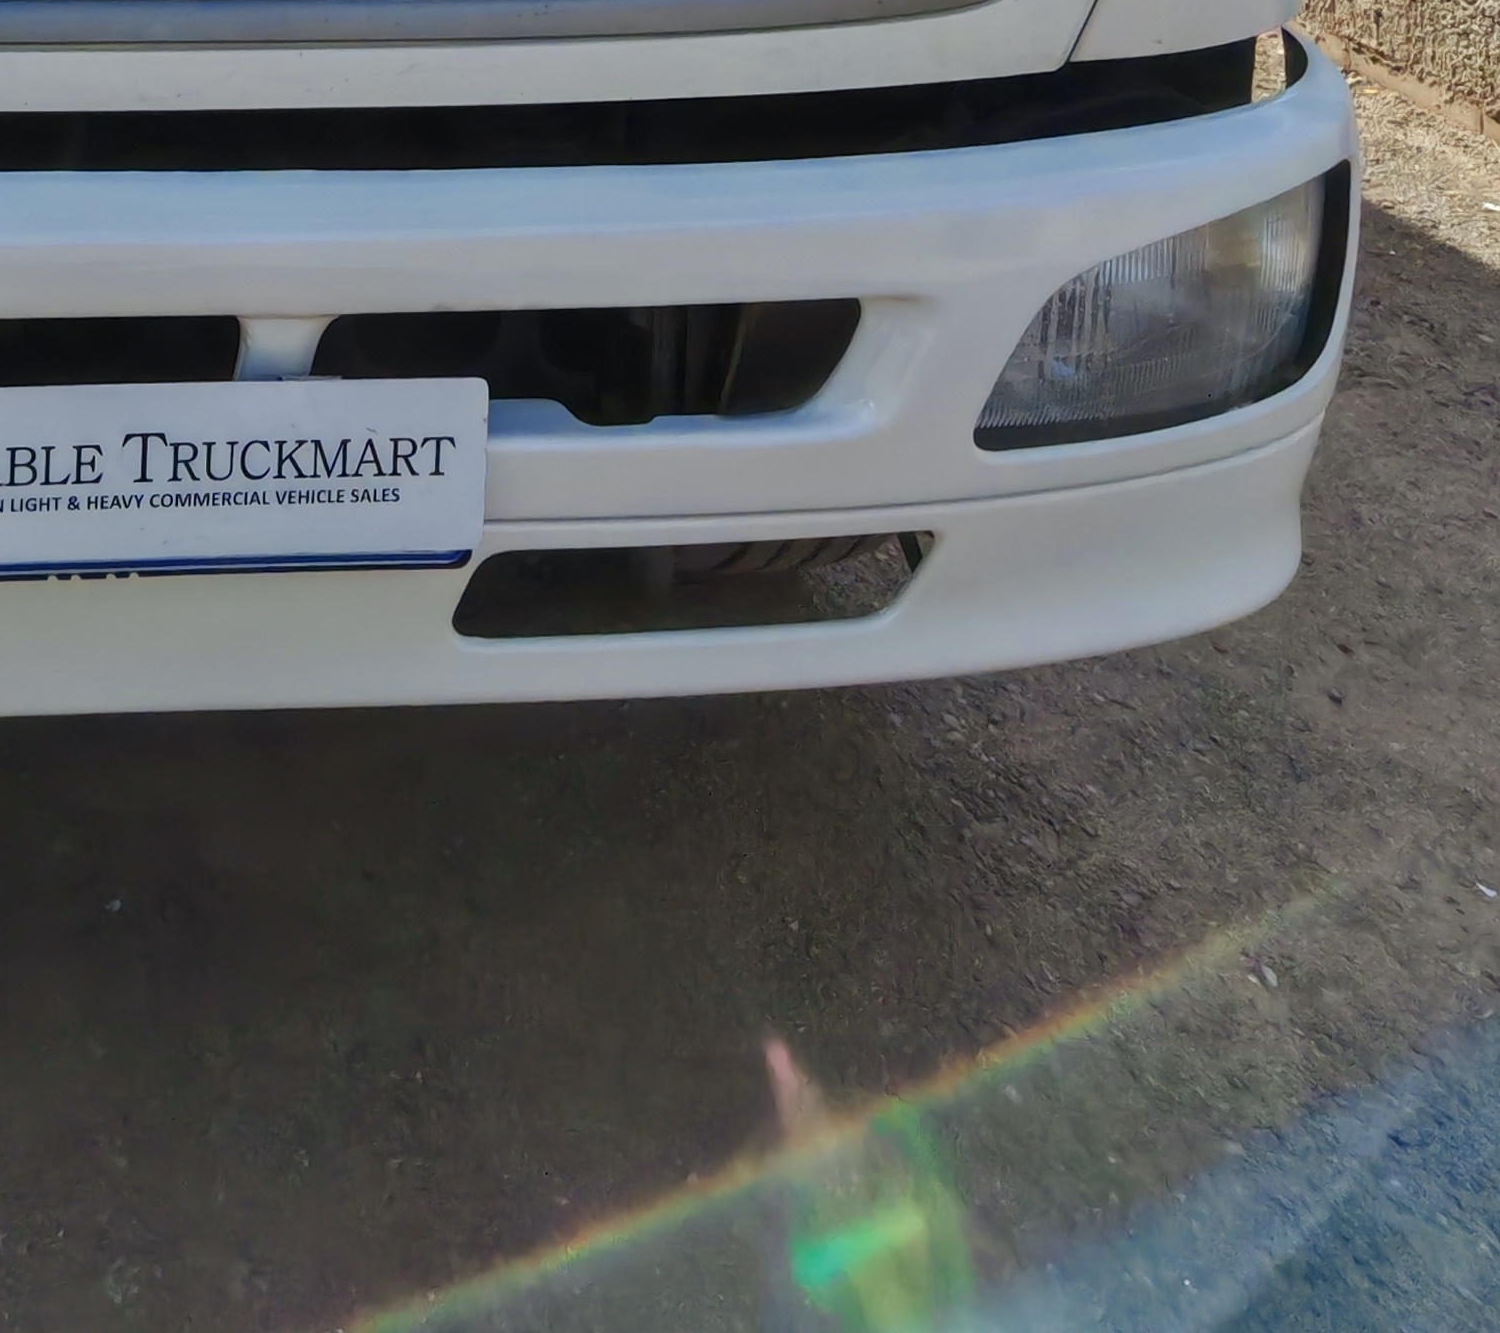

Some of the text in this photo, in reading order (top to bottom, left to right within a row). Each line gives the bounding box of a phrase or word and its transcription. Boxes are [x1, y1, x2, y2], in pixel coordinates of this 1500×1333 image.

[121, 432, 457, 484] TRUCKMART
[10, 496, 62, 513] LIGHT
[66, 495, 81, 511] &
[86, 493, 144, 511] HEAVY
[149, 490, 271, 508] COMMERCIAL
[275, 488, 345, 505] VEHICLE
[350, 487, 401, 504] SALES
